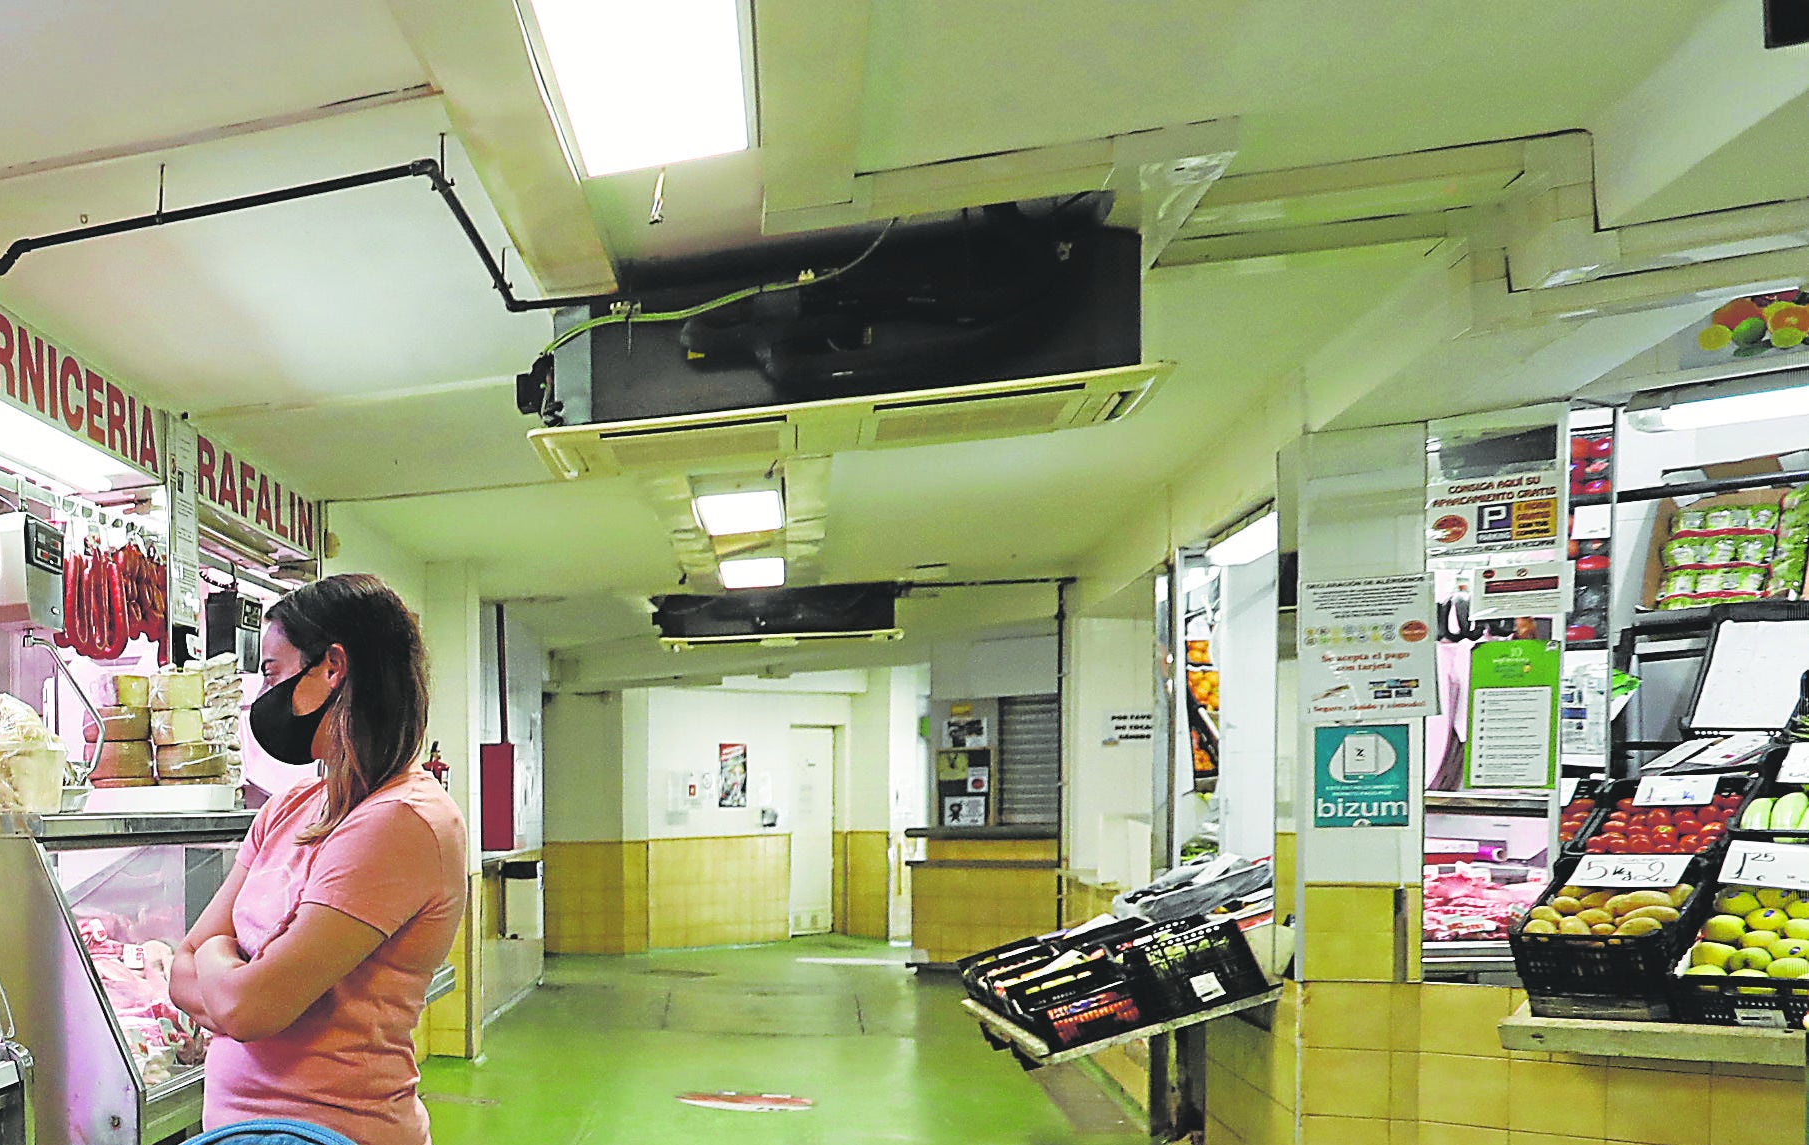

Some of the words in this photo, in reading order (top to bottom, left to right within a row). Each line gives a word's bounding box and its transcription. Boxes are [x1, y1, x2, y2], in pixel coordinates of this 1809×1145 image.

[197, 434, 313, 552] RAFALIN
[1448, 481, 1495, 495] CONSIGA
[1496, 476, 1523, 488] AQUÍ
[1525, 475, 1542, 485] SU
[1516, 486, 1557, 499] GRATIS
[1482, 505, 1508, 530] P
[1317, 798, 1408, 818] bizum
[1580, 860, 1609, 881] 5
